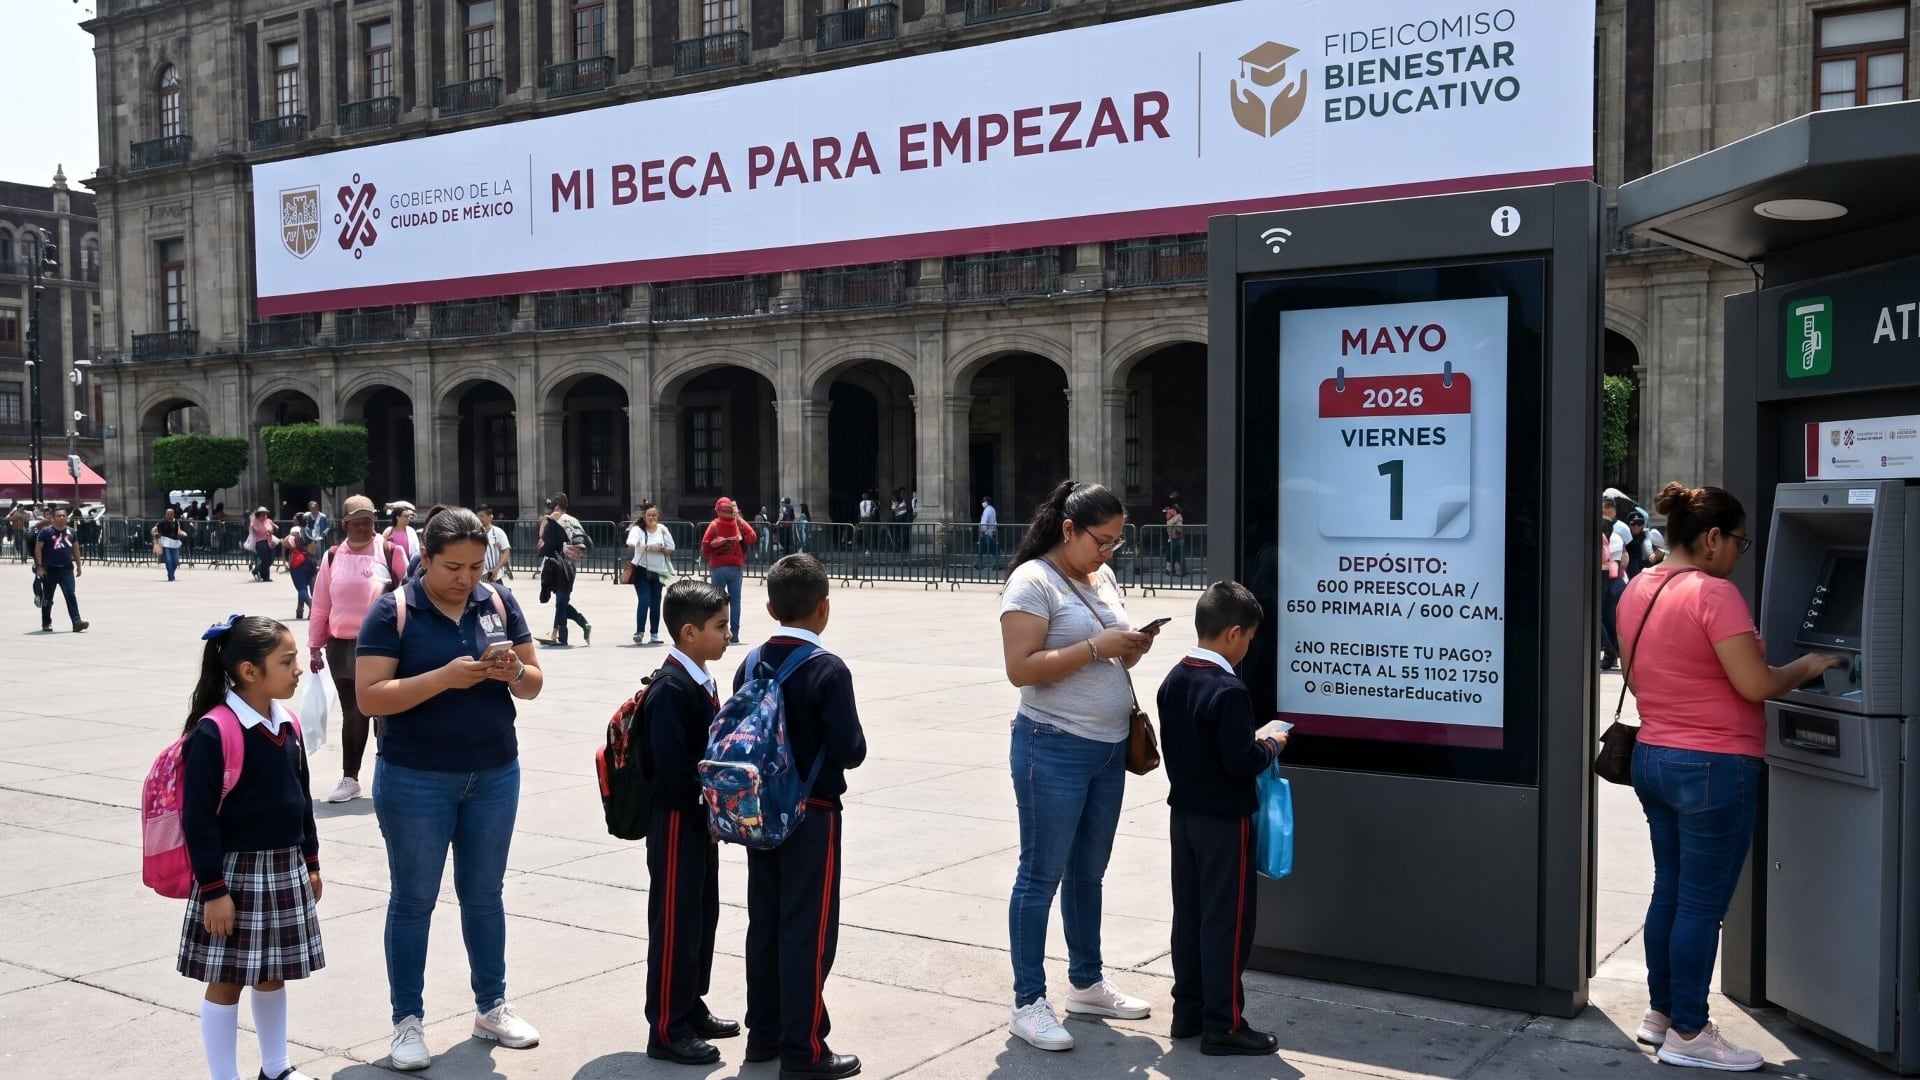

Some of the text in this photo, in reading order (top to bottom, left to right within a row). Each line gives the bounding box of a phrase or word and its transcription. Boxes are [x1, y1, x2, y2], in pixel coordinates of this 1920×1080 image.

[1324, 9, 1515, 56] FIDEICOMISO
[1324, 40, 1515, 90] BIENESTAR
[1324, 76, 1521, 123] EDUCATIVO
[551, 90, 1171, 213] MI BECA PARA EMPEZAR
[390, 179, 513, 209] GOBIERNO DE LA
[390, 201, 514, 229] CIUDAD DE MÉXICO
[1872, 302, 1920, 344] AT
[1341, 323, 1447, 356] MAYO
[1362, 387, 1424, 409] 2026
[1341, 426, 1447, 448] VIERNES
[1377, 459, 1404, 521] 1
[1338, 553, 1448, 575] DEPÓSITO:
[1317, 579, 1349, 594] 600
[1354, 580, 1466, 598] PREESCOLAR
[1286, 600, 1316, 614] 650
[1321, 601, 1402, 617] PRIMARIA
[1420, 604, 1454, 619] 600
[1459, 606, 1504, 621] CAM.
[1294, 640, 1493, 663] ¿NO RECIBISTE TU PAGO?
[1290, 660, 1499, 684] CONTACTA AL 55 1102 1750
[1304, 680, 1483, 704] O @BienestarEducativo
